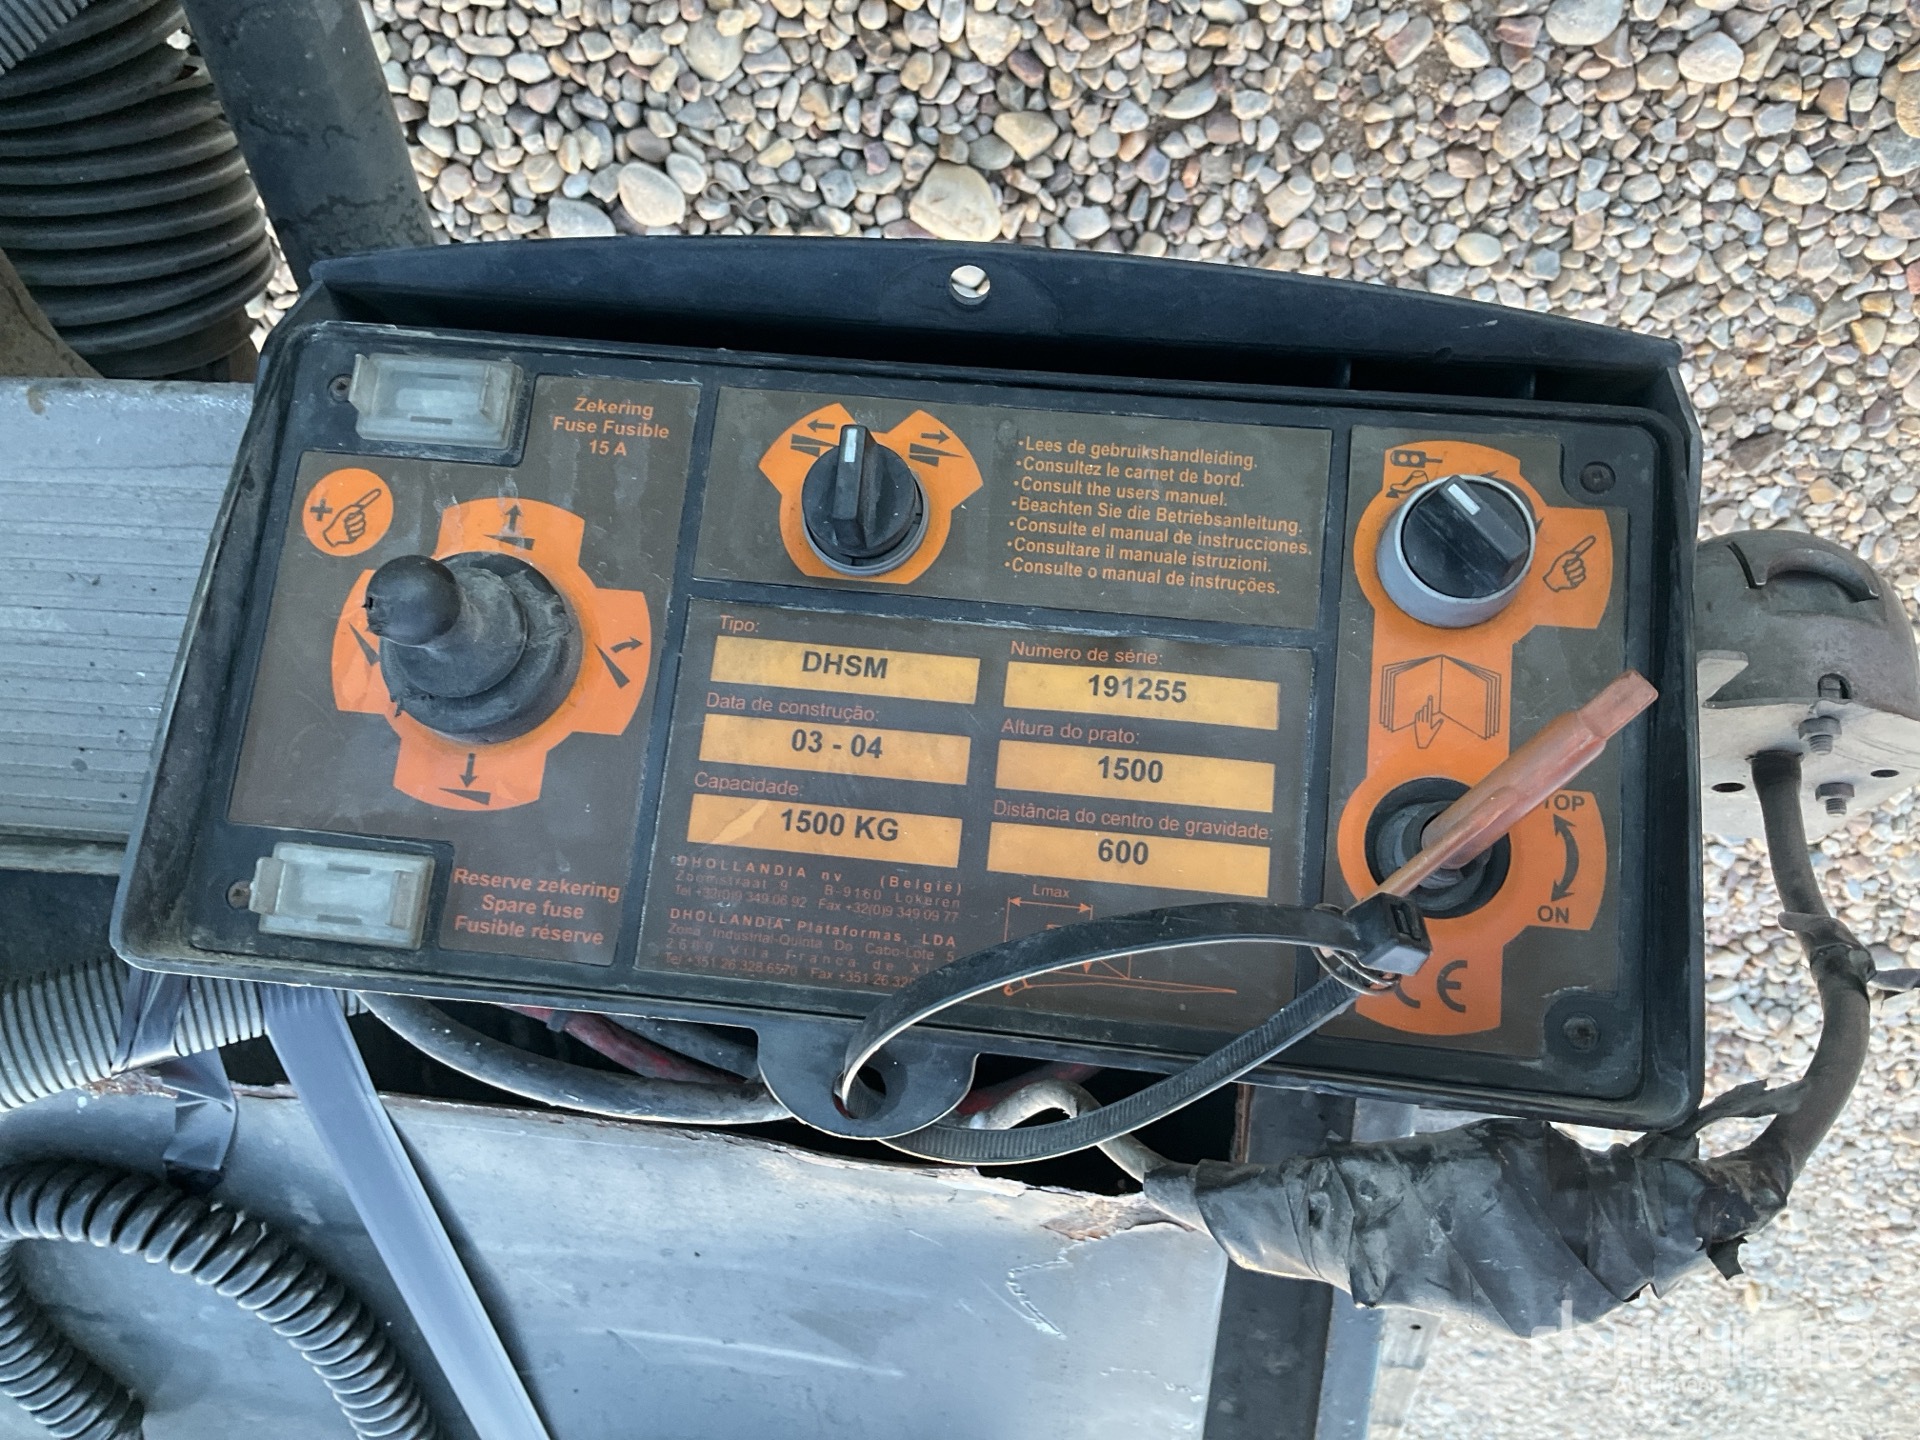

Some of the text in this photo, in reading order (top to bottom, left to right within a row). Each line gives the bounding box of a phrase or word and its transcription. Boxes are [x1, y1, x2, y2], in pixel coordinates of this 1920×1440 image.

[574, 397, 654, 420] Zekering
[553, 416, 669, 439] Fuse Fusible
[590, 439, 627, 456] 15 A
[1067, 440, 1086, 454] de
[1089, 443, 1257, 470] gebruikshandleiding.
[1106, 462, 1120, 477] le
[1124, 465, 1174, 481] carnet
[1179, 468, 1198, 484] de
[1203, 469, 1245, 487] bord.
[1087, 481, 1111, 497] the
[1116, 486, 1160, 501] users
[1165, 490, 1228, 506] manuel.
[1097, 502, 1122, 518] Sie
[1127, 504, 1151, 521] die
[1156, 507, 1303, 537] Betriebsanleitung.
[1091, 523, 1106, 538] el
[1110, 526, 1168, 543] manual
[1173, 529, 1193, 545] de
[1198, 530, 1312, 555] instrucciones.
[1105, 544, 1115, 559] il
[1119, 548, 1187, 565] manuale
[1192, 551, 1271, 573] istruzioni.
[1087, 567, 1098, 579] o
[1102, 567, 1161, 584] manual
[1166, 570, 1185, 586] de
[1190, 572, 1280, 596] instruções.
[719, 614, 759, 633] Tipo:
[801, 650, 889, 679] DHSM
[1087, 648, 1109, 662] de
[1114, 649, 1163, 666] série:
[1088, 674, 1188, 703] 191255
[706, 692, 880, 724] Data de construção:
[791, 728, 823, 753] 03
[851, 734, 883, 759] 04
[1001, 717, 1140, 745] Altura do prato:
[1098, 755, 1164, 784] 1500
[781, 808, 899, 842] 1500 KG
[993, 800, 1273, 841] Distância do centro de gravidade:
[1098, 838, 1149, 865] 600
[677, 855, 806, 878] DHOLLANDIA
[453, 867, 620, 904] Reserve zekering
[1032, 883, 1071, 899] Lmax
[481, 894, 585, 920] Spare fuse
[818, 898, 841, 911] Fax
[896, 906, 920, 919] 349
[944, 911, 960, 923] 77
[895, 892, 960, 908] Lokeren
[669, 907, 784, 931] DHOLLANDIA
[921, 933, 956, 948] LDA
[1537, 905, 1570, 924] ON
[454, 915, 604, 945] Fusible réserve
[834, 938, 854, 953] Do
[811, 967, 834, 980] Fax
[872, 959, 895, 972] de
